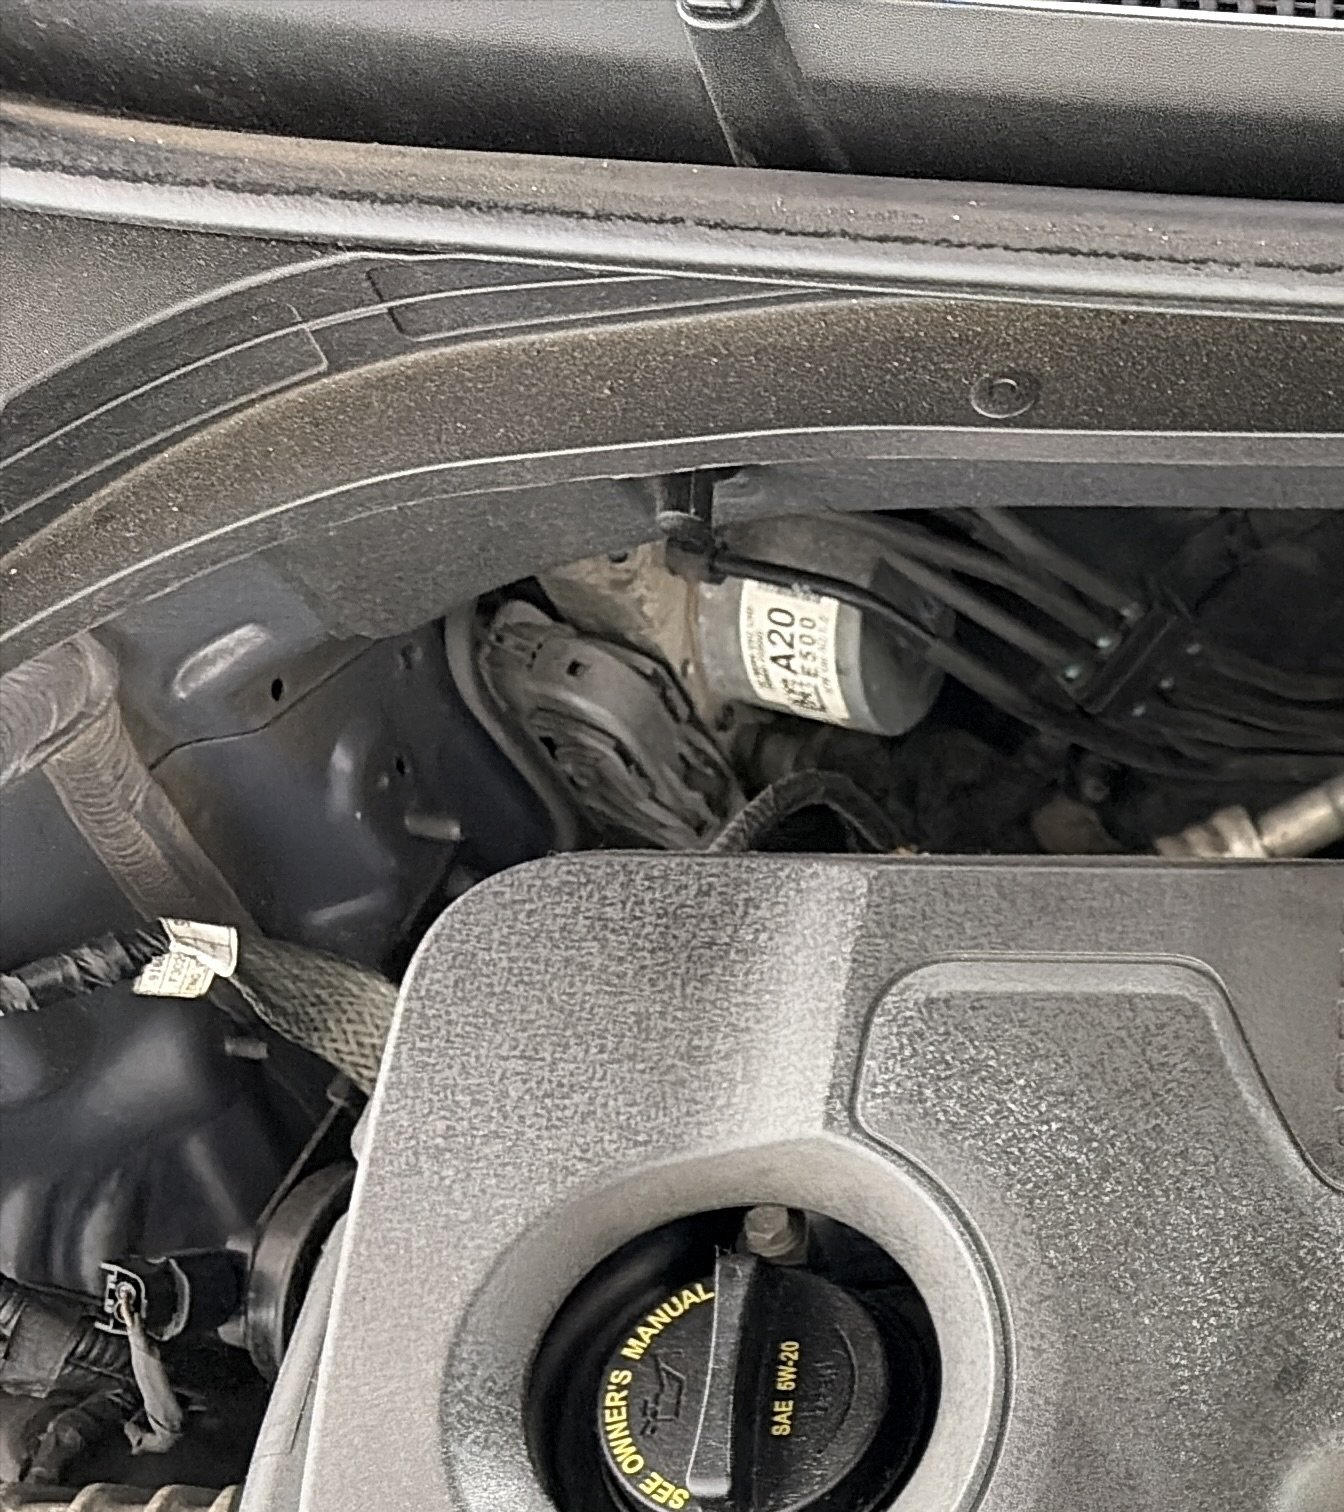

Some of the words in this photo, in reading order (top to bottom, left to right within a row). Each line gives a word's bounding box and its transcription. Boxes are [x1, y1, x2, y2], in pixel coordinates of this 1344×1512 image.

[766, 606, 798, 675] A20
[798, 616, 819, 678] E500
[620, 1281, 715, 1360] MANUAL
[778, 1340, 800, 1391] 5W-20
[604, 1369, 646, 1474] OWNER'S
[769, 1400, 794, 1436] SAE
[638, 1471, 691, 1509] SEE
